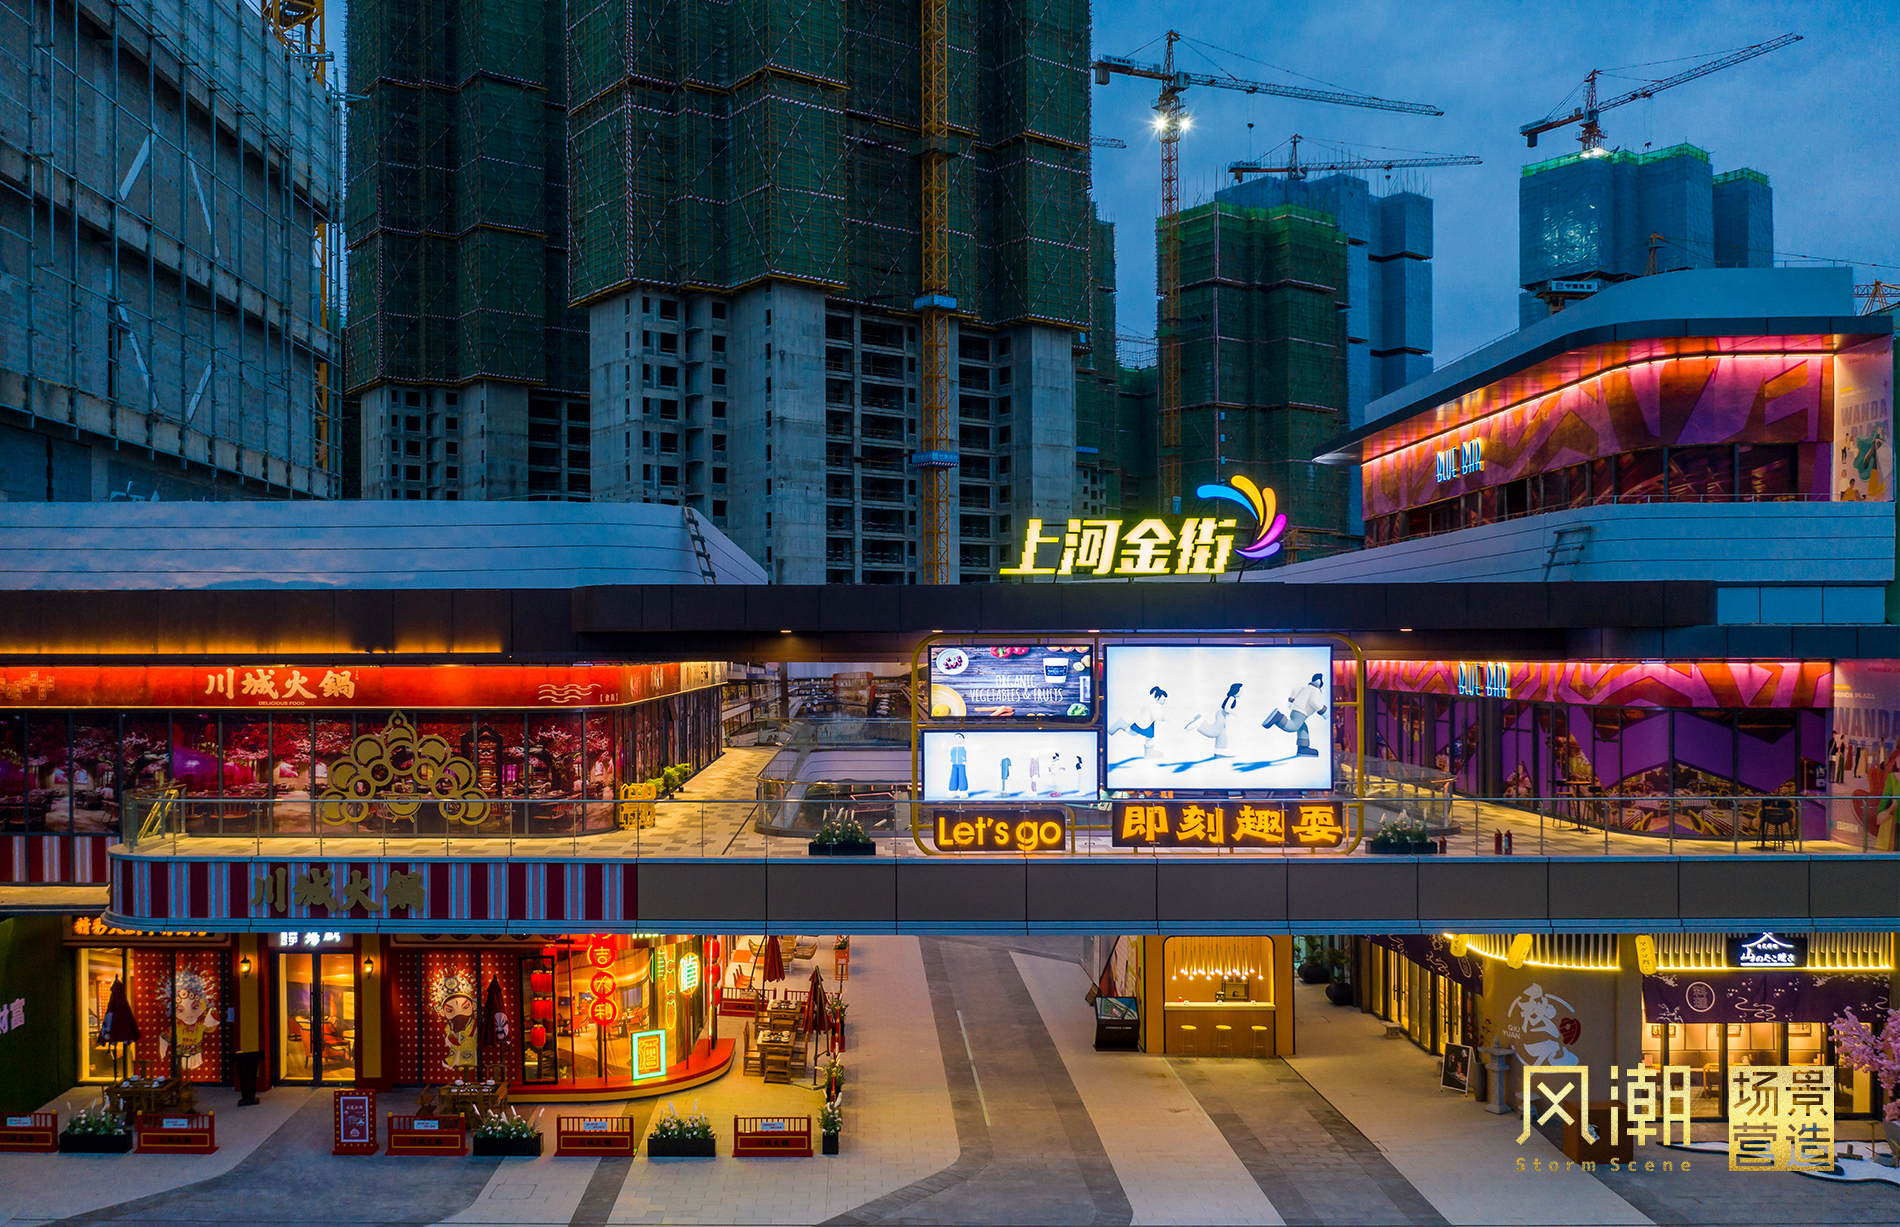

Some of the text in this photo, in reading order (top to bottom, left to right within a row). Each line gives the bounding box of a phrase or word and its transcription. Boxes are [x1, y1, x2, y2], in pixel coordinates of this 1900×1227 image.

[1841, 398, 1888, 427] WANDA
[1436, 439, 1482, 483] BLUE BAR
[999, 518, 1237, 575] 上河金街
[205, 668, 355, 699] 川城火鍋
[970, 687, 1064, 702] VEGETABLES & FRUITS
[995, 675, 1036, 688] ORGANIC
[1458, 662, 1508, 697] BLUE BAR
[939, 817, 1062, 851] Let's go
[1122, 805, 1343, 844] 即刻趣耍
[1502, 1030, 1521, 1040] YUAN
[1507, 1024, 1521, 1033] QIU
